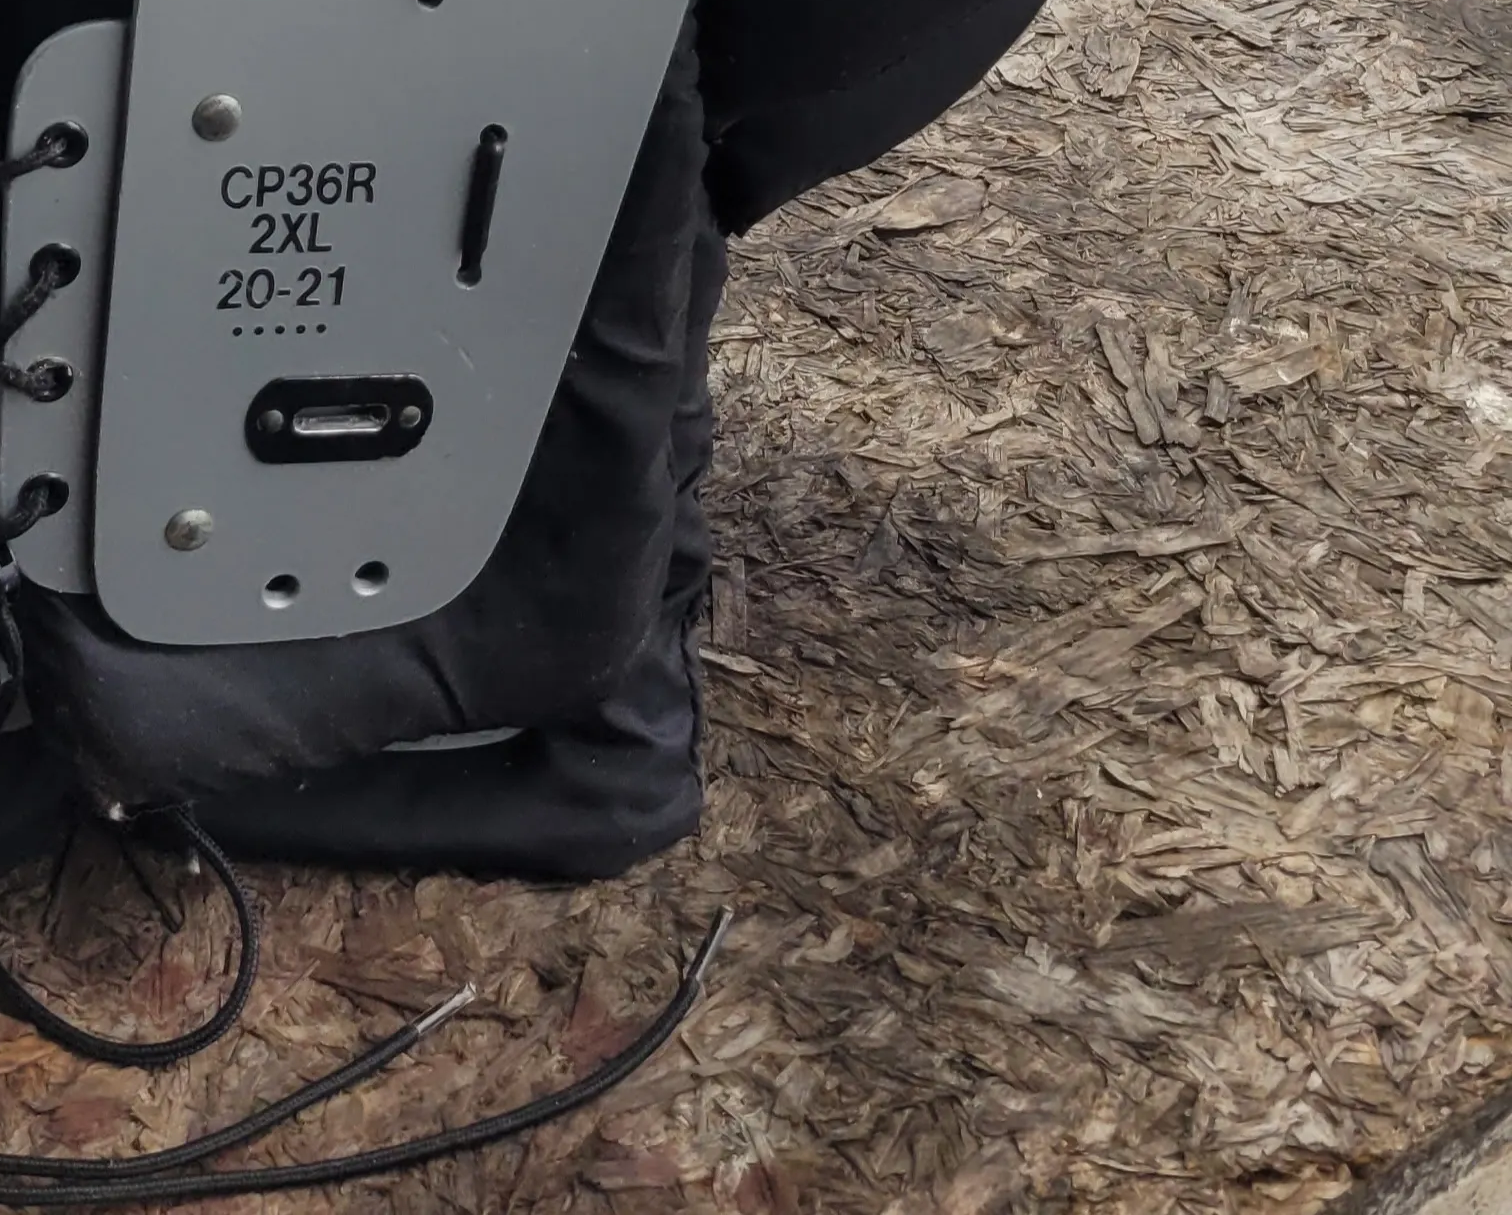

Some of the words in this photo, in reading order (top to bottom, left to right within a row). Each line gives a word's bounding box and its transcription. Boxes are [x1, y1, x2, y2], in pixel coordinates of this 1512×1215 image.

[221, 161, 377, 209] CP36R
[248, 211, 333, 254] 2XL
[216, 265, 346, 310] 20-21
